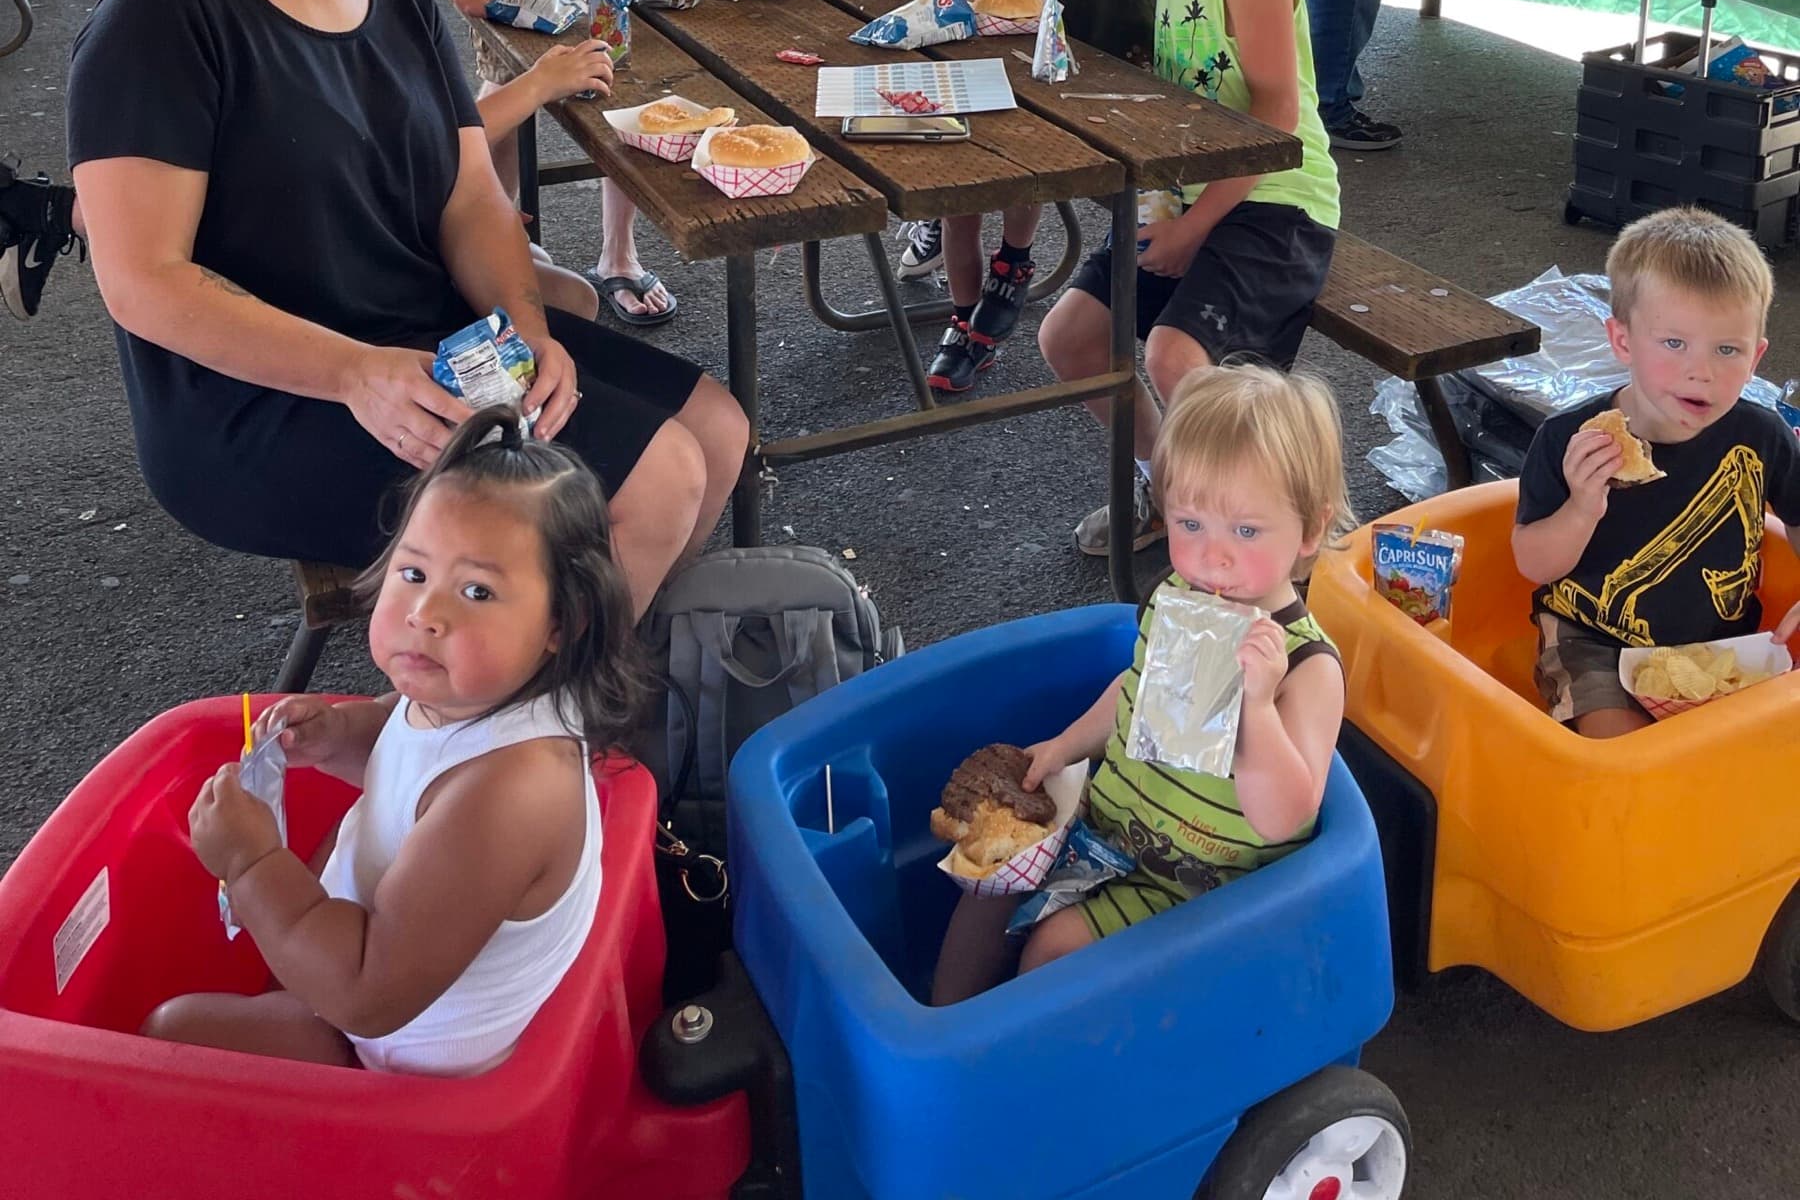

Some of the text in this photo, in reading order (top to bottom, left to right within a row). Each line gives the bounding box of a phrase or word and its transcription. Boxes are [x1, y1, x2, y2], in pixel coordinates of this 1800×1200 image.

[1379, 546, 1416, 565] CAPRI
[1416, 550, 1449, 572] SUN
[1177, 820, 1240, 863] hanging
